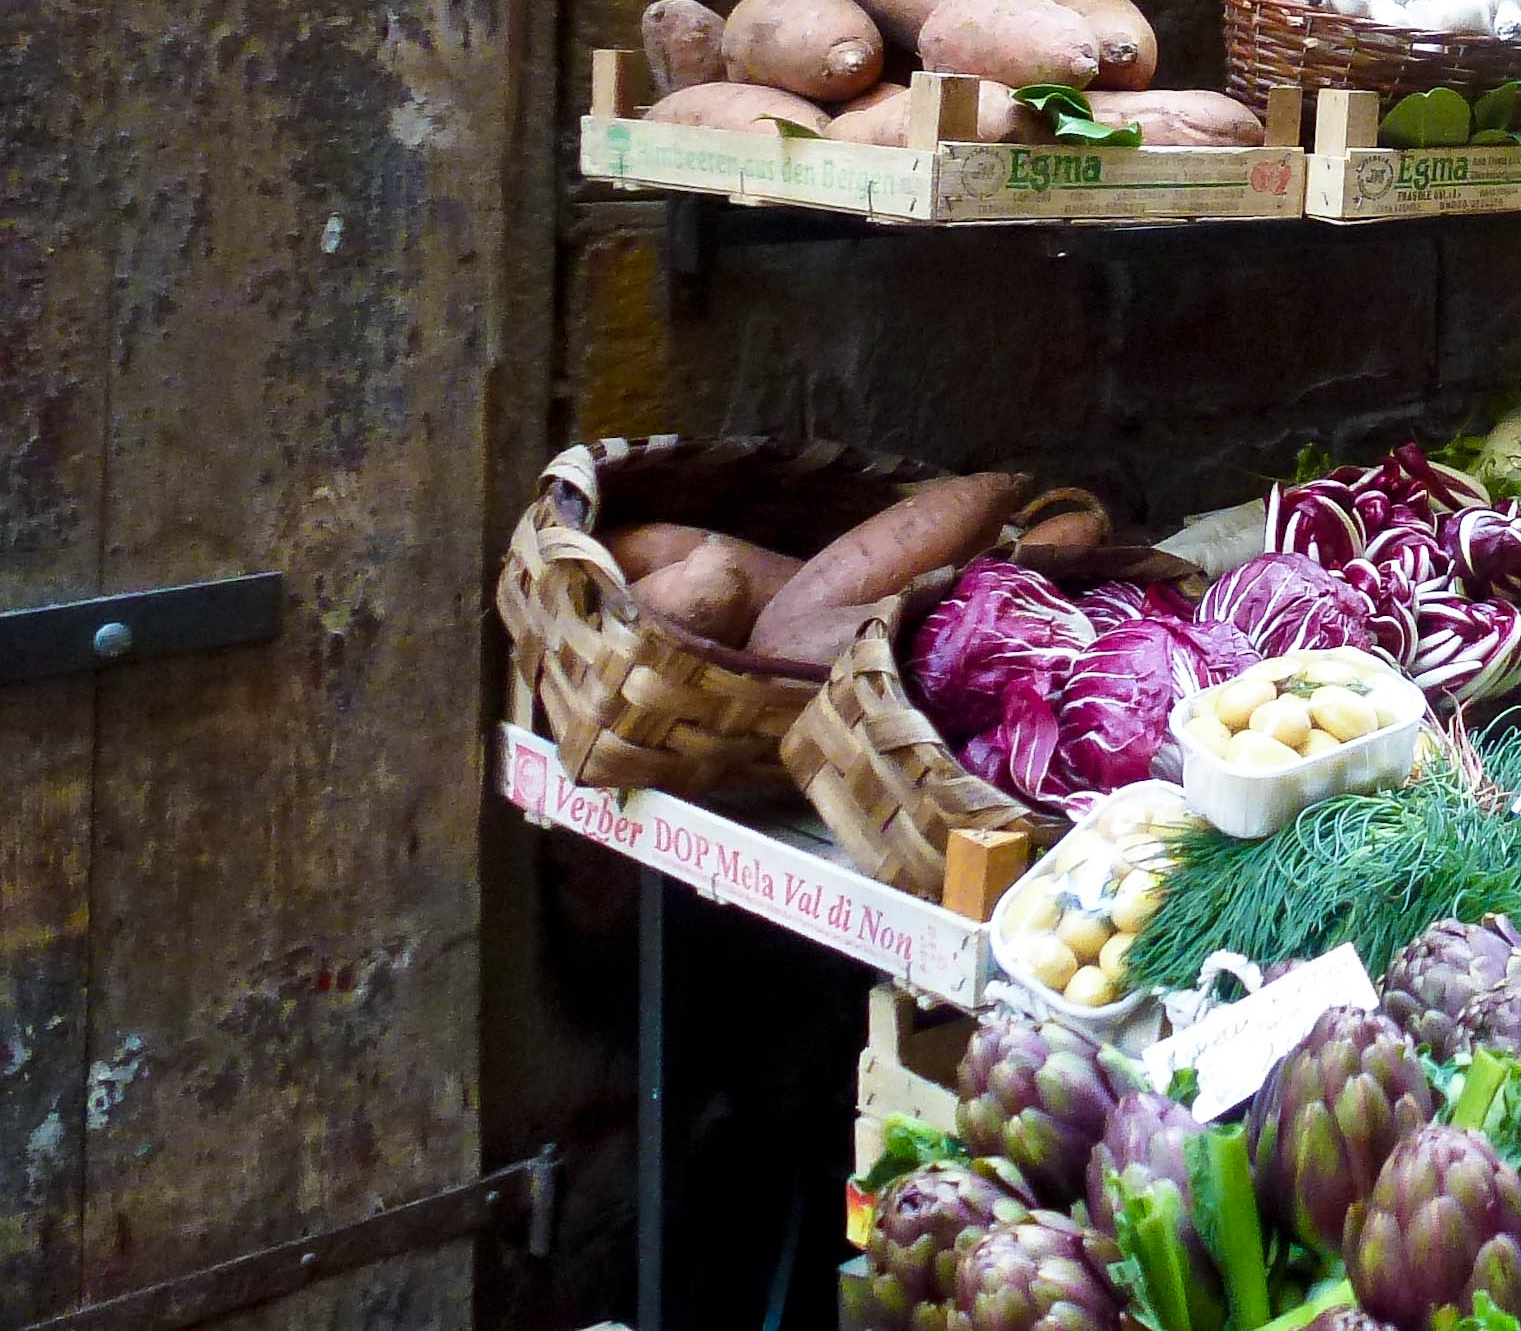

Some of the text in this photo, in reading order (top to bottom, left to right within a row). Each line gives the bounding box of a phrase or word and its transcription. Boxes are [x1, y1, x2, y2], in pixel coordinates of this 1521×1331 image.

[1008, 148, 1103, 193] Egma
[1397, 149, 1469, 190] Egma
[553, 772, 644, 850] Verber
[653, 815, 711, 870] DOP
[716, 841, 776, 902] Mela
[782, 870, 824, 920] Val
[827, 892, 854, 933] di
[857, 902, 913, 962] Non
